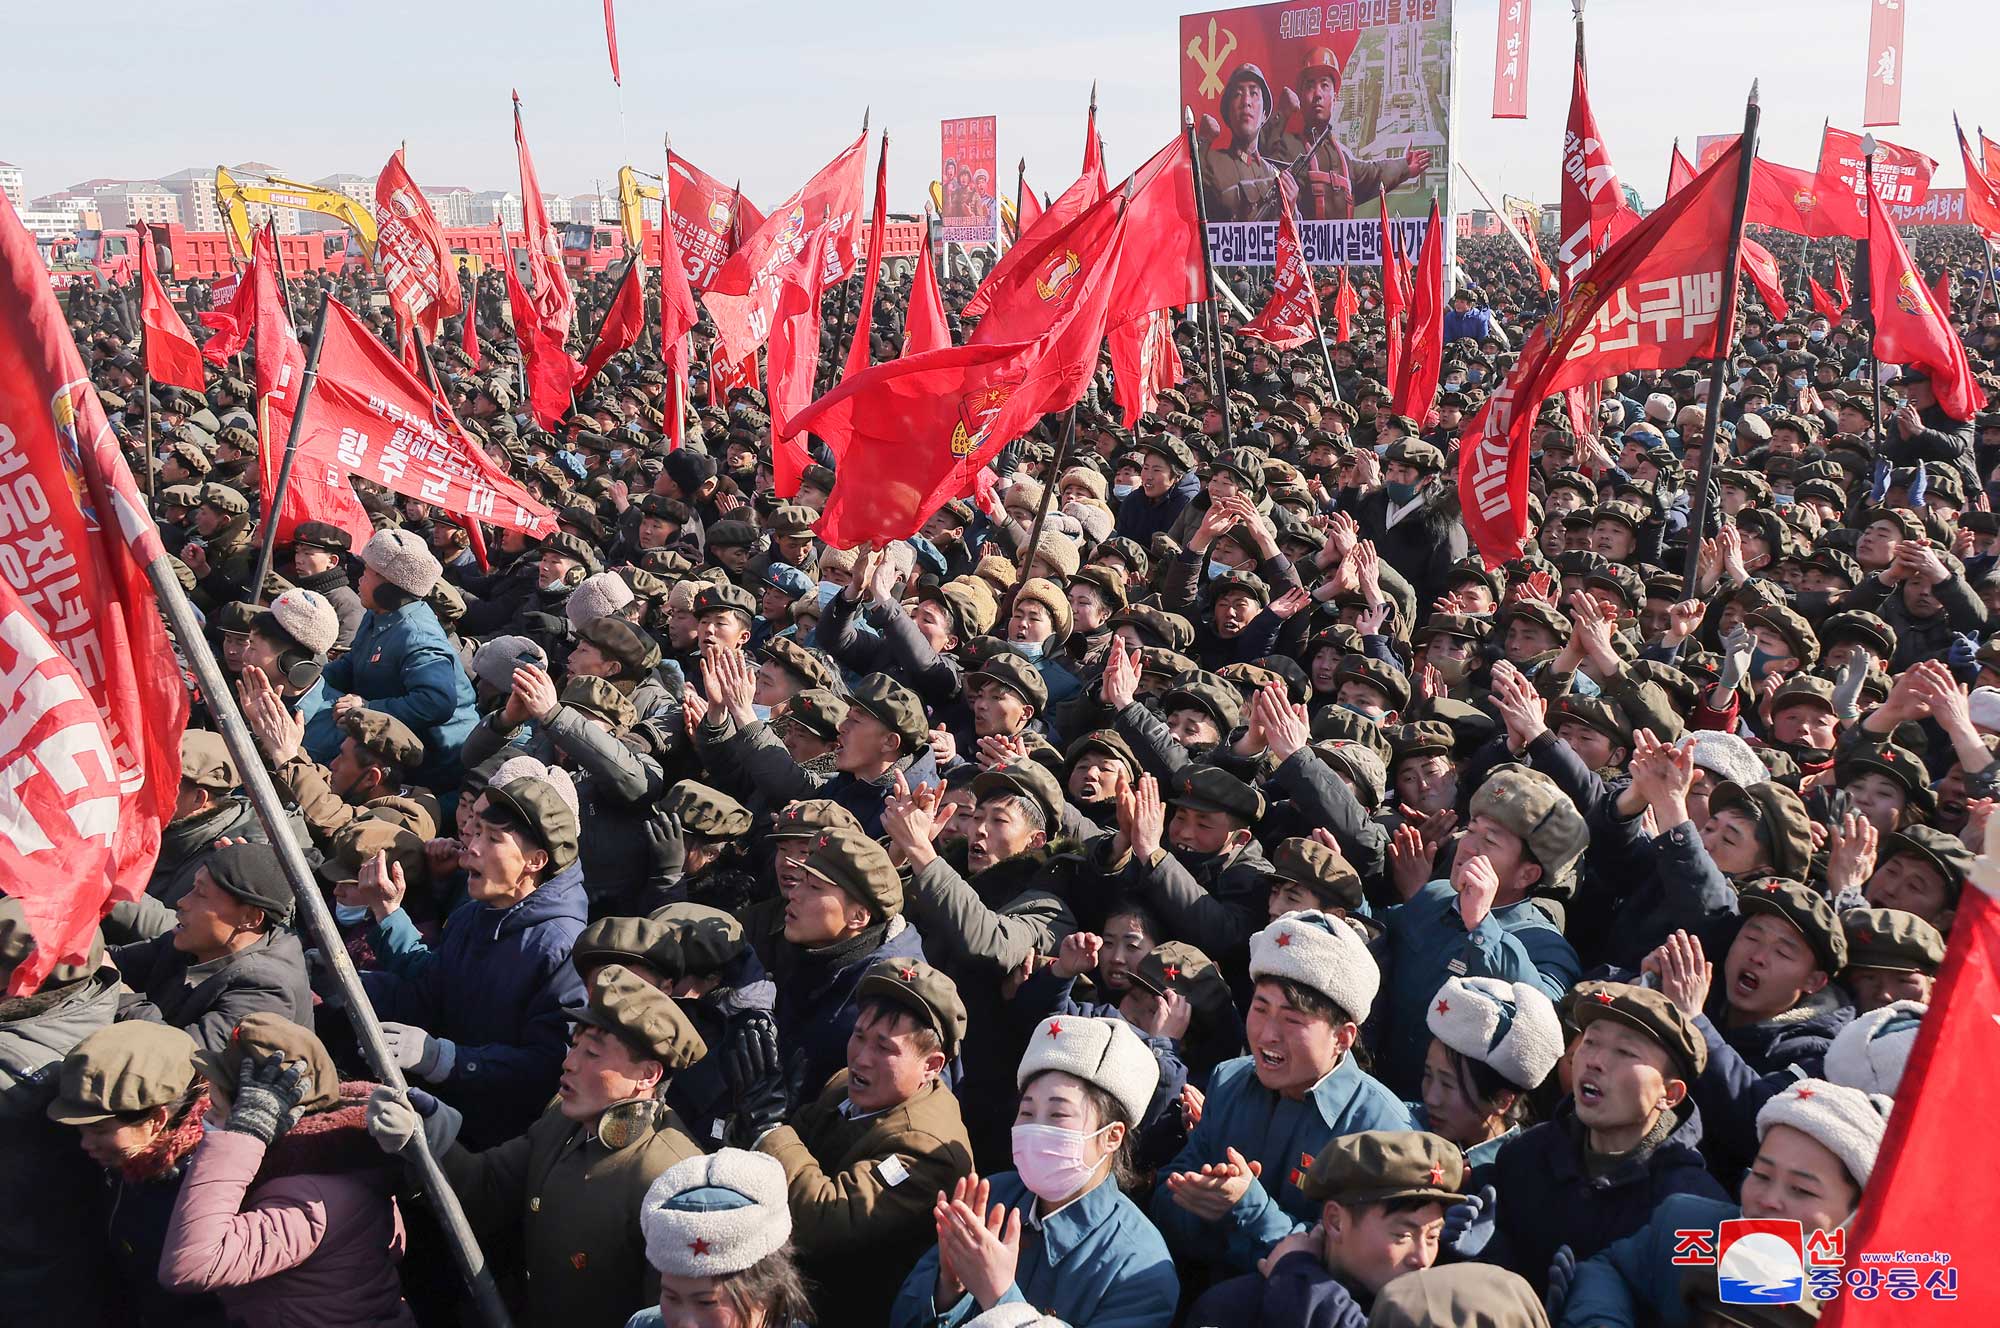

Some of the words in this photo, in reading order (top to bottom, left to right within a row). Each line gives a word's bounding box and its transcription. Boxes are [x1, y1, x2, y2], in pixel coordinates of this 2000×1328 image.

[1280, 7, 1322, 39] 위대한
[1326, 2, 1355, 33] 우리
[1357, 0, 1402, 29] 인민을
[1405, 0, 1436, 26] 위한
[1503, 32, 1521, 102] 만세!
[1839, 157, 1917, 177] 백두산웅청년돌격대
[1208, 226, 1247, 263] 구상과
[1249, 223, 1280, 262] 의도
[1303, 222, 1345, 262] 장에서
